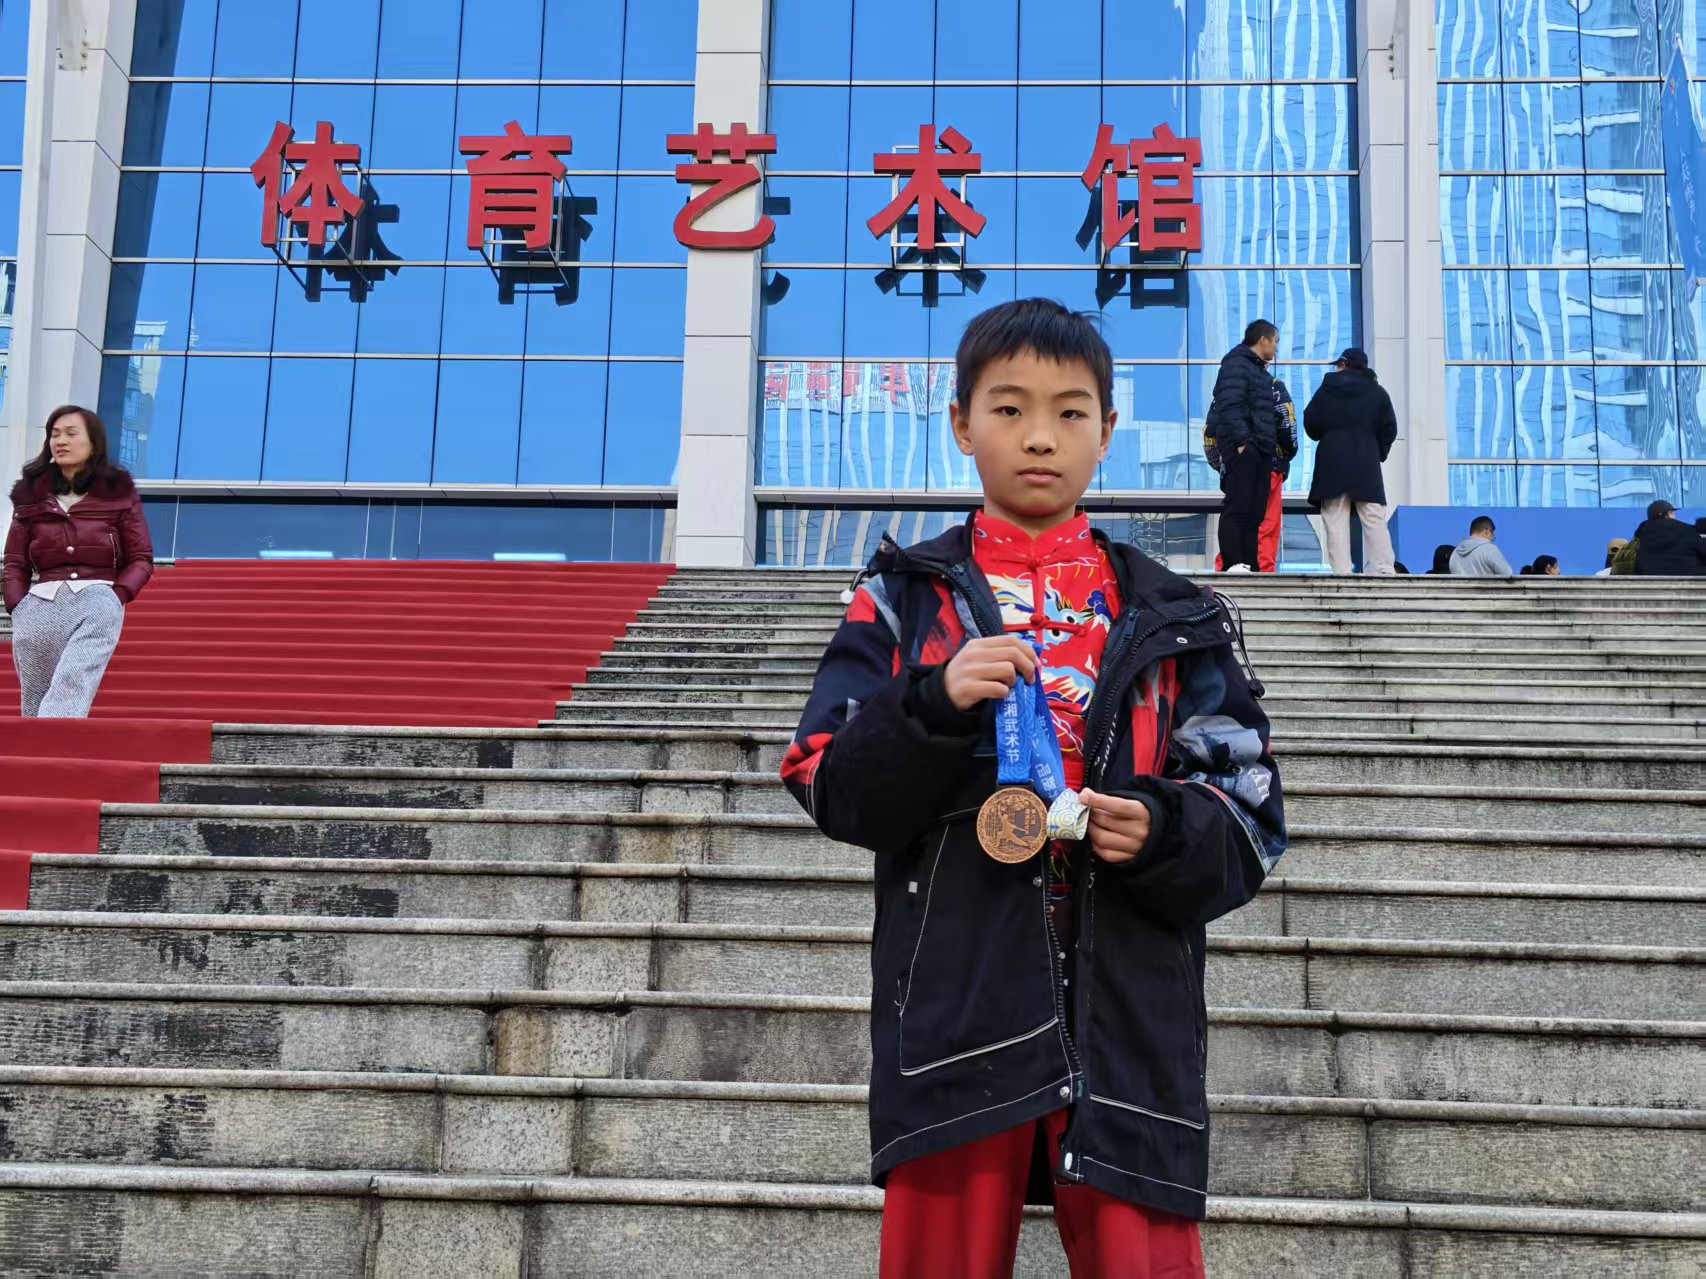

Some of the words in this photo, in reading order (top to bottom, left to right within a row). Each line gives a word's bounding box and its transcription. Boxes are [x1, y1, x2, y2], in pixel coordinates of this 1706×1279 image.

[250, 120, 1202, 252] 体育艺术馆
